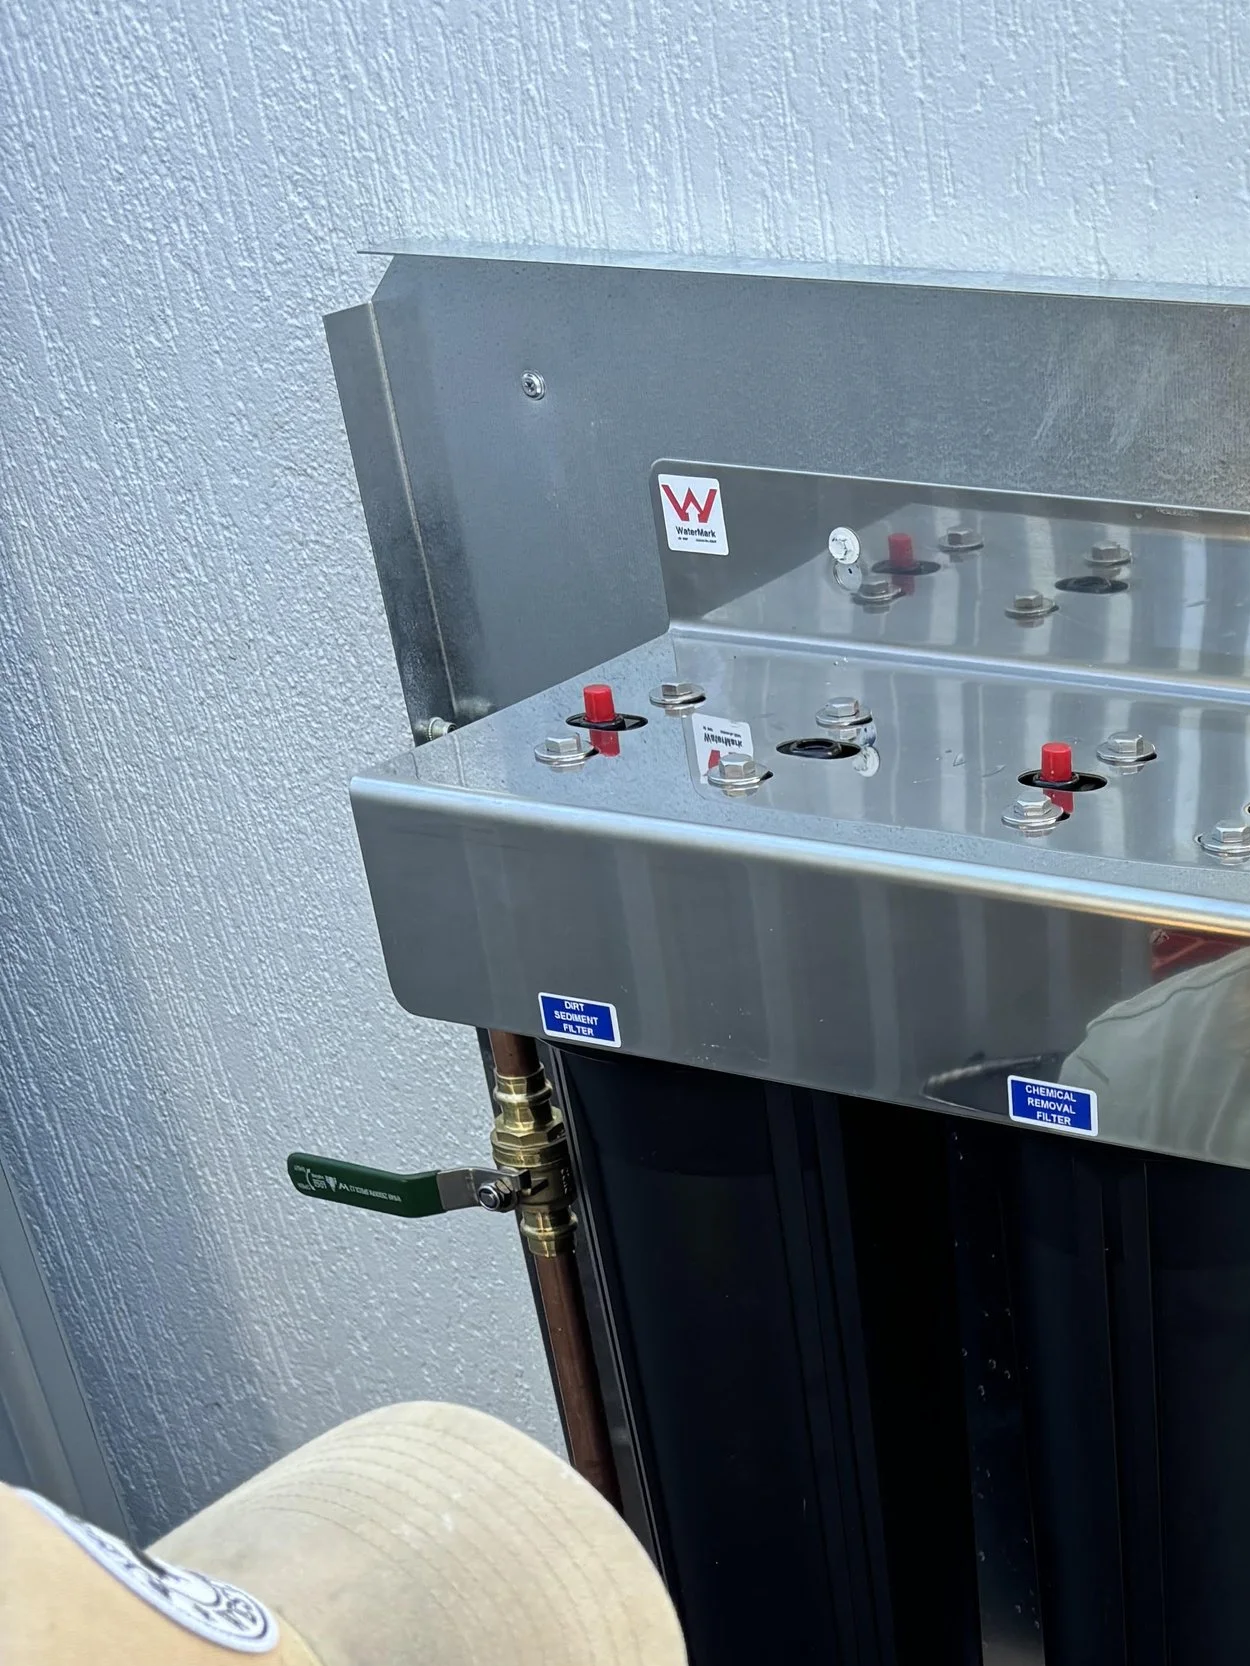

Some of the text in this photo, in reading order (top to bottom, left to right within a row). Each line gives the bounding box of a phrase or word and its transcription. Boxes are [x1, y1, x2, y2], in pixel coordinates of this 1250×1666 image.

[676, 525, 716, 538] WaterMark
[564, 1000, 585, 1012] DIRT
[554, 1010, 599, 1026] SEDIMENT
[563, 1023, 594, 1036] FILTER
[1025, 1084, 1077, 1102] CHEMICAL
[1027, 1097, 1076, 1115] REMOVAL
[1036, 1111, 1071, 1125] FILTER
